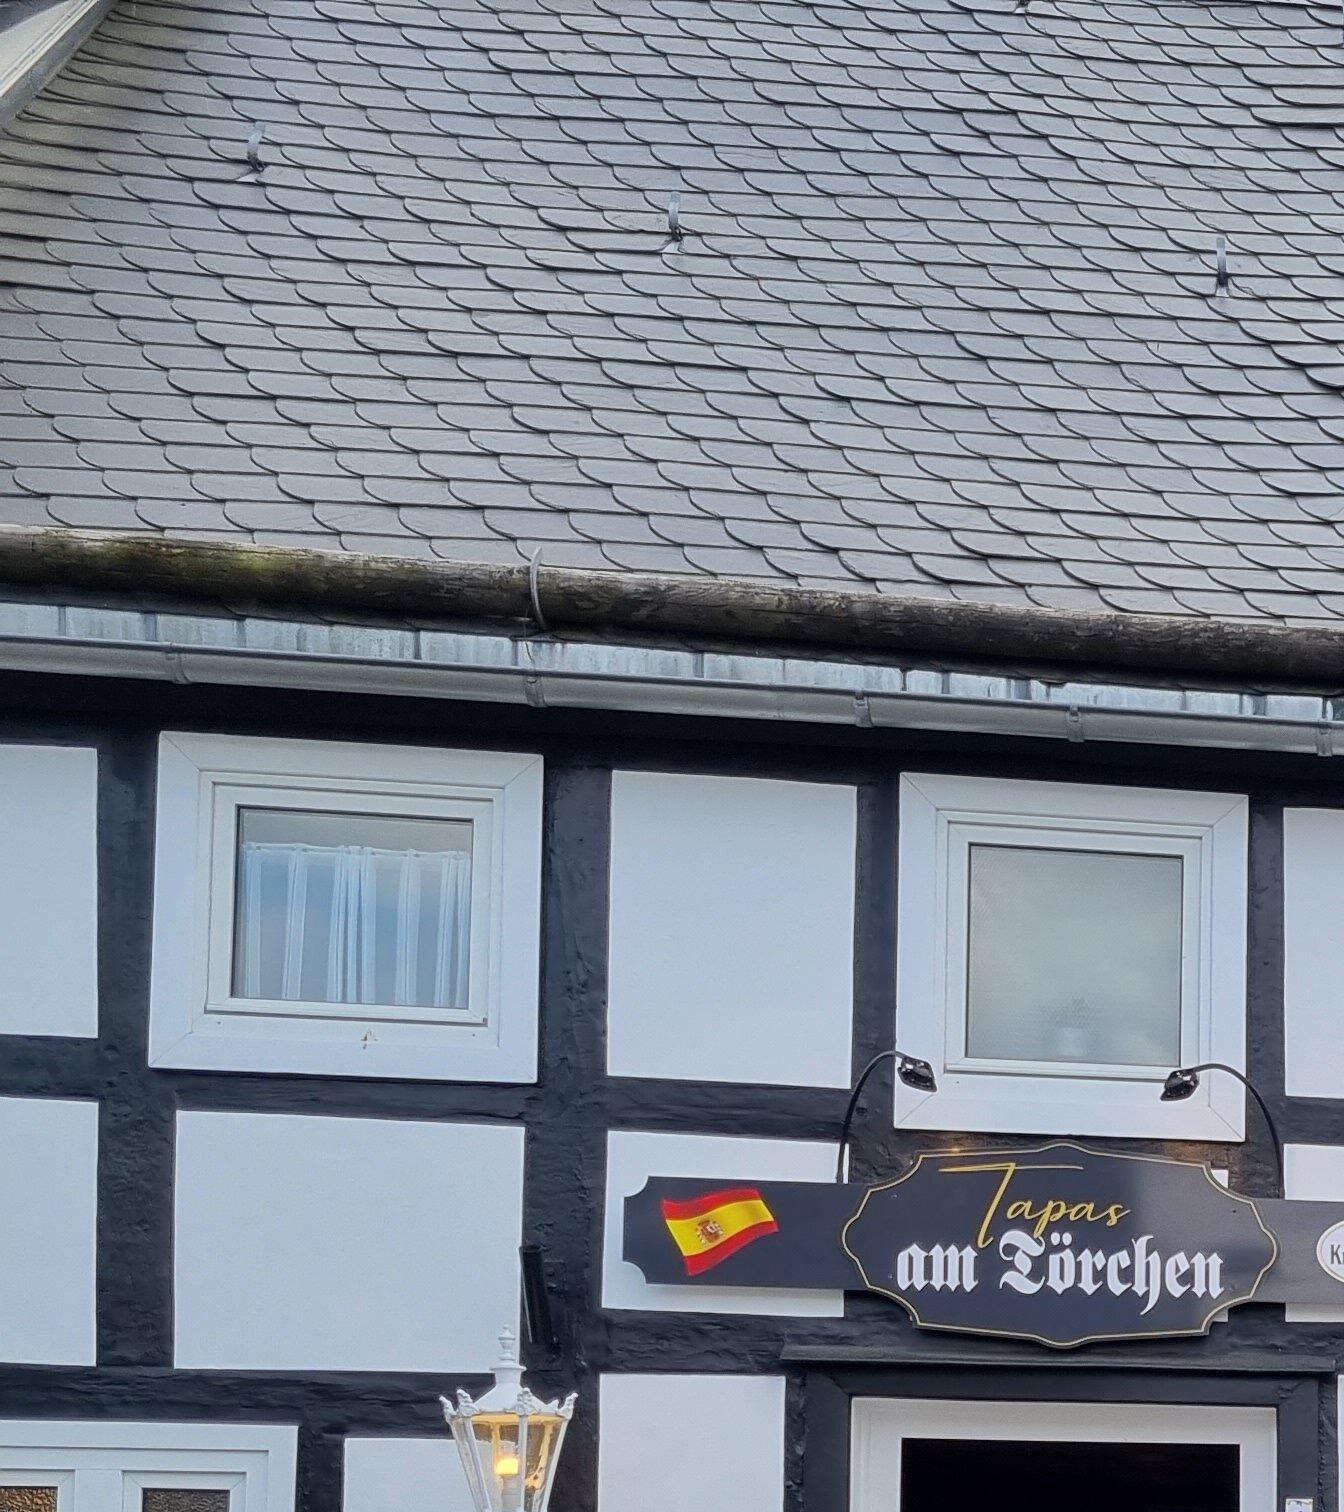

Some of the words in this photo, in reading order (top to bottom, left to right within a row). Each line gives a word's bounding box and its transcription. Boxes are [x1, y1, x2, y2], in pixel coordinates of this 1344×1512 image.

[938, 1162, 1131, 1249] Tapas
[896, 1243, 979, 1293] am
[999, 1229, 1225, 1316] Törchen
